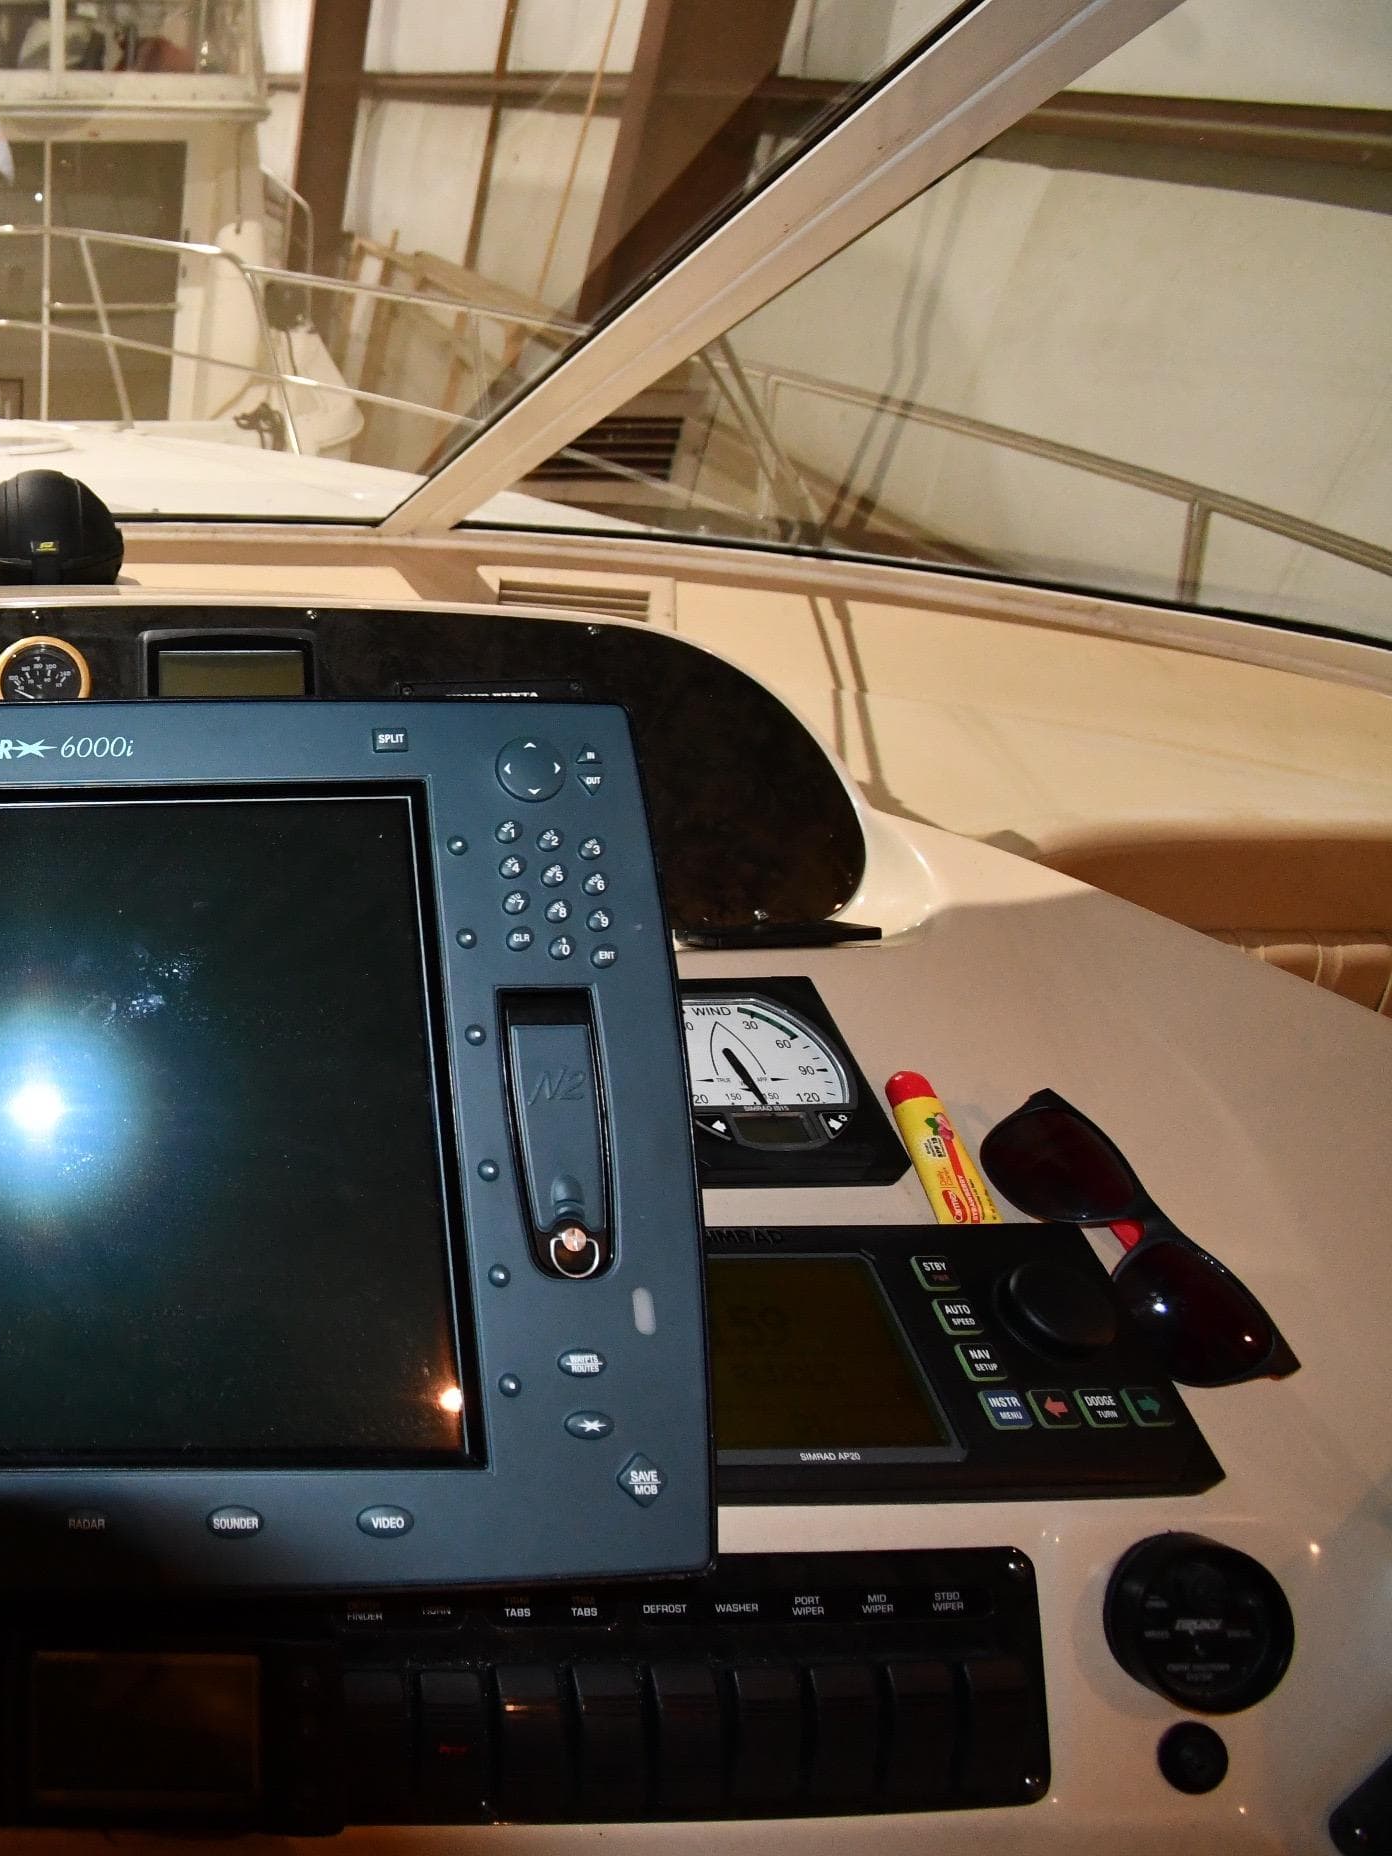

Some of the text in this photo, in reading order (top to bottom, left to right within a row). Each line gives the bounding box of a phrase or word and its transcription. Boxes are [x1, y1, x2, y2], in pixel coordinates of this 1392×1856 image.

[378, 733, 404, 744] SPLIT
[60, 736, 135, 760] 6000i
[586, 752, 596, 760] IN
[586, 776, 602, 785] OUT
[509, 828, 516, 838] 1
[551, 836, 559, 846] 2
[593, 844, 600, 854] 3
[512, 862, 520, 873] 4
[556, 872, 564, 882] 5
[596, 880, 605, 891] 6
[517, 900, 525, 910] 7
[558, 907, 567, 918] 8
[600, 916, 608, 928] 9
[512, 934, 530, 942] CLR
[561, 944, 570, 956] 0
[598, 951, 616, 960] ENT
[691, 1006, 732, 1017] WIND
[742, 1020, 758, 1031] 30
[776, 1040, 792, 1050] 60
[798, 1066, 816, 1076] 90
[693, 1094, 710, 1104] 20
[725, 1093, 742, 1101] 150
[796, 1092, 821, 1104] 120
[922, 1262, 947, 1272] STBY
[944, 1304, 971, 1315] AUTO
[952, 1318, 976, 1326] SPEED
[568, 1354, 600, 1364] WAYPTS
[968, 1349, 991, 1360] NAV
[570, 1364, 600, 1373] ROUTES
[974, 1363, 998, 1372] SETUP
[988, 1397, 1021, 1408] INSTR
[1084, 1396, 1116, 1406] DODGE
[999, 1411, 1023, 1420] MENU
[1096, 1410, 1118, 1418] TURN
[800, 1452, 861, 1462] SIMRAD AP20
[630, 1470, 660, 1482] SAVE
[634, 1484, 659, 1495] MOB
[68, 1518, 106, 1530] RADAR
[213, 1517, 259, 1530] SOUNDER
[371, 1516, 404, 1529] VIDEO
[794, 1596, 820, 1606] PORT
[868, 1594, 887, 1603] MID
[934, 1592, 960, 1601] STBD
[571, 1607, 598, 1617] TABS
[642, 1604, 688, 1614] DEFROST
[715, 1602, 759, 1612] WASHER
[792, 1606, 825, 1616] WIPER
[862, 1604, 894, 1614] WIPER
[932, 1602, 964, 1612] WIPER
[504, 1608, 532, 1618] TABS
